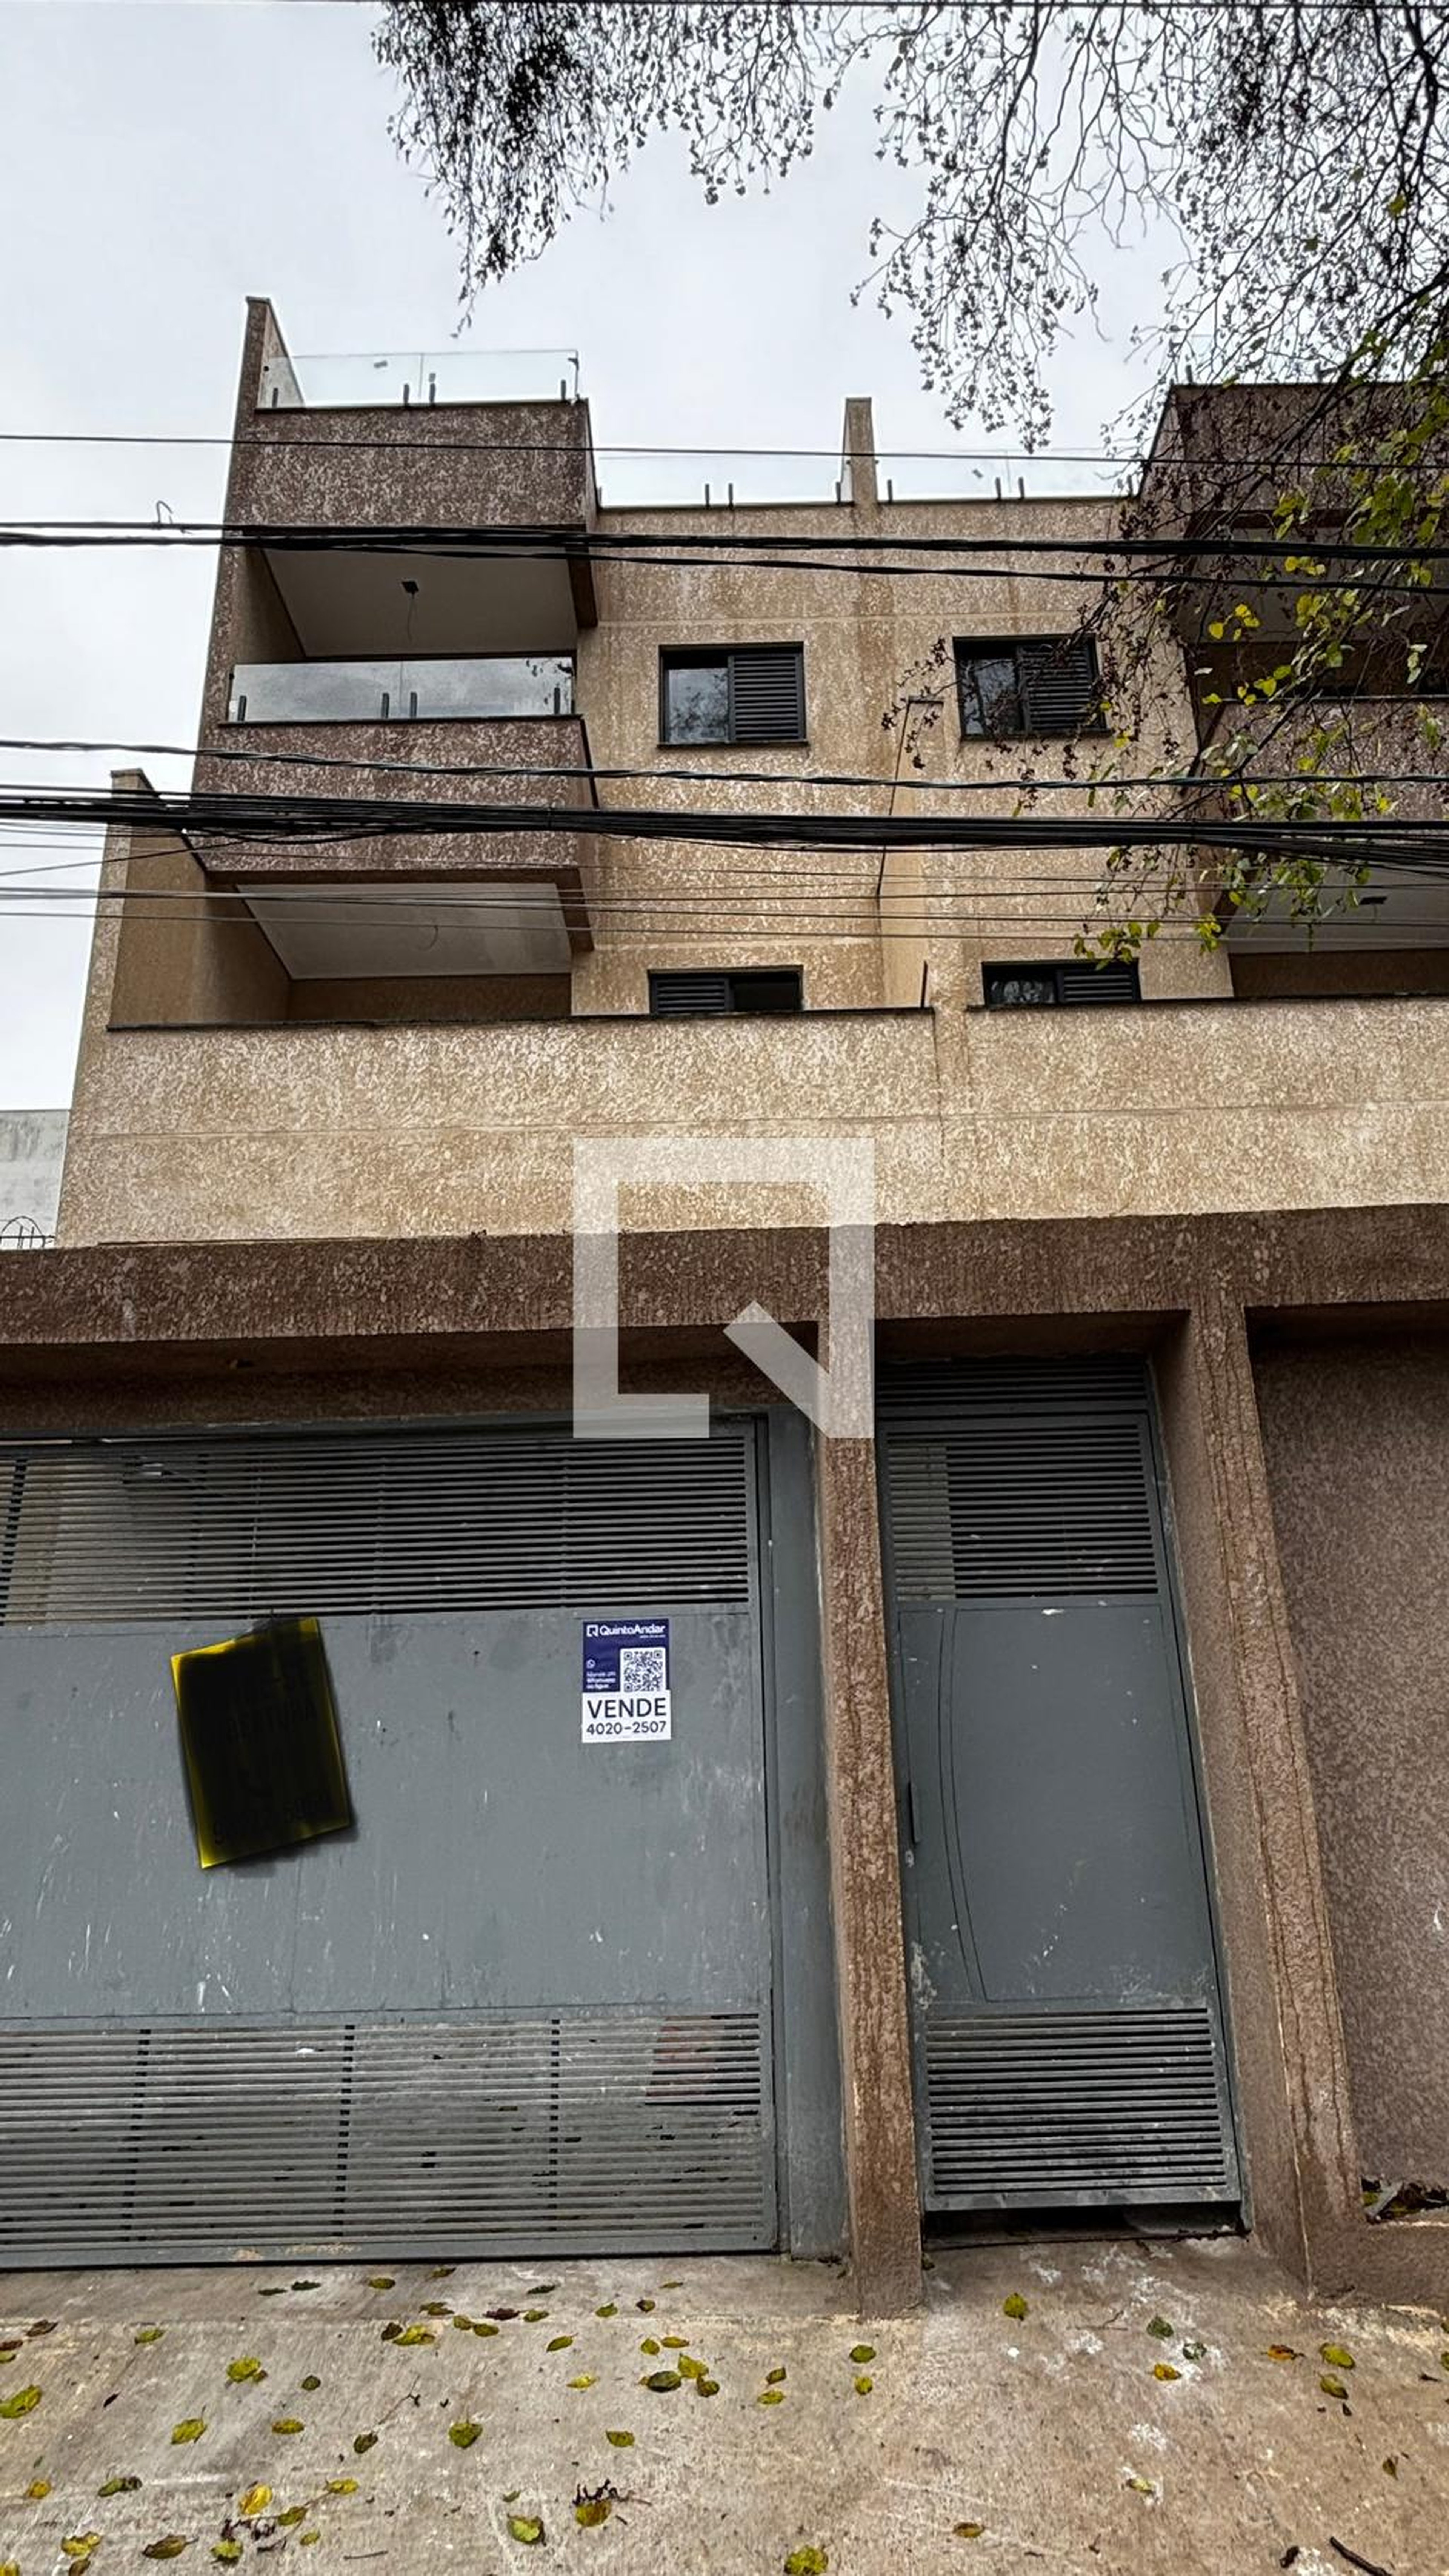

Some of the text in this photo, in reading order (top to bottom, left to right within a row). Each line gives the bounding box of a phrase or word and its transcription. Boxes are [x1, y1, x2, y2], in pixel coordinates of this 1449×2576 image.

[600, 1624, 666, 1635] QuintoAndar
[587, 1698, 666, 1719] VENDE
[587, 1721, 666, 1735] 4020-2507
